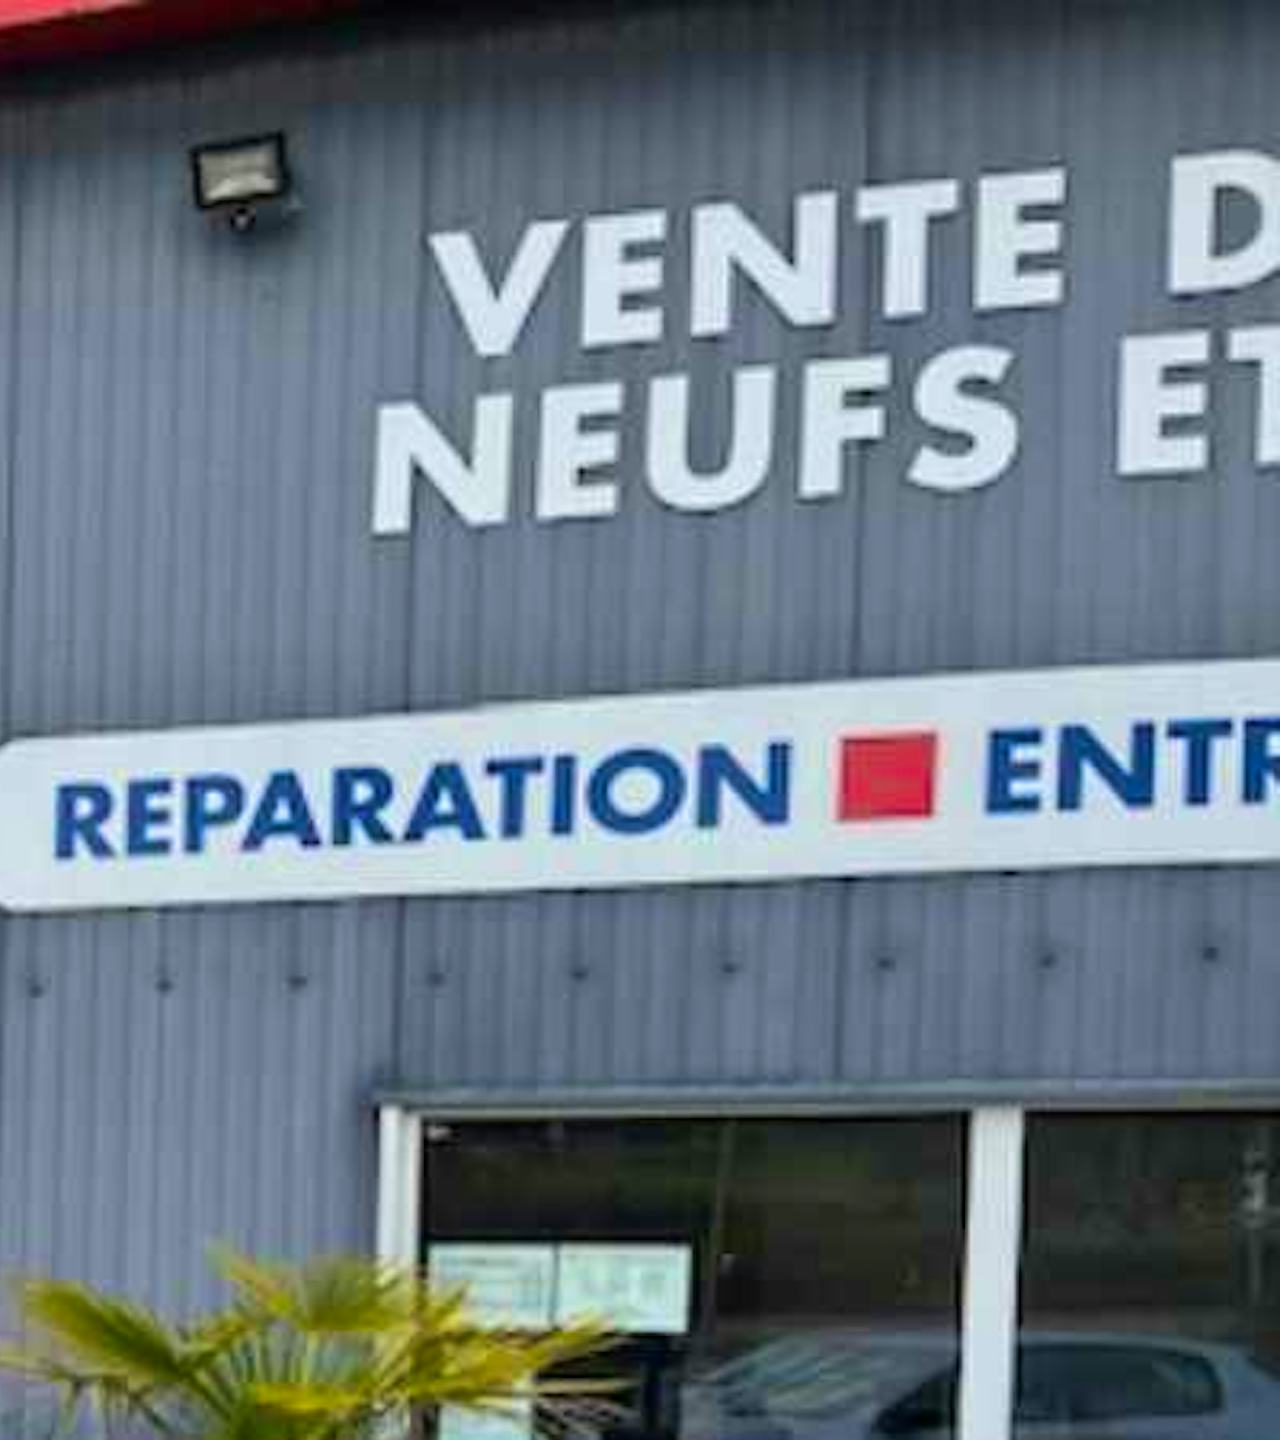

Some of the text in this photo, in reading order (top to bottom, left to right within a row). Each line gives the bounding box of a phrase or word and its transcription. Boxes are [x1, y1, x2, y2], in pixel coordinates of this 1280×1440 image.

[426, 150, 1280, 358] VENTE D
[370, 344, 1022, 536] NEUFS
[52, 714, 1280, 860] REPARATION ENTR
